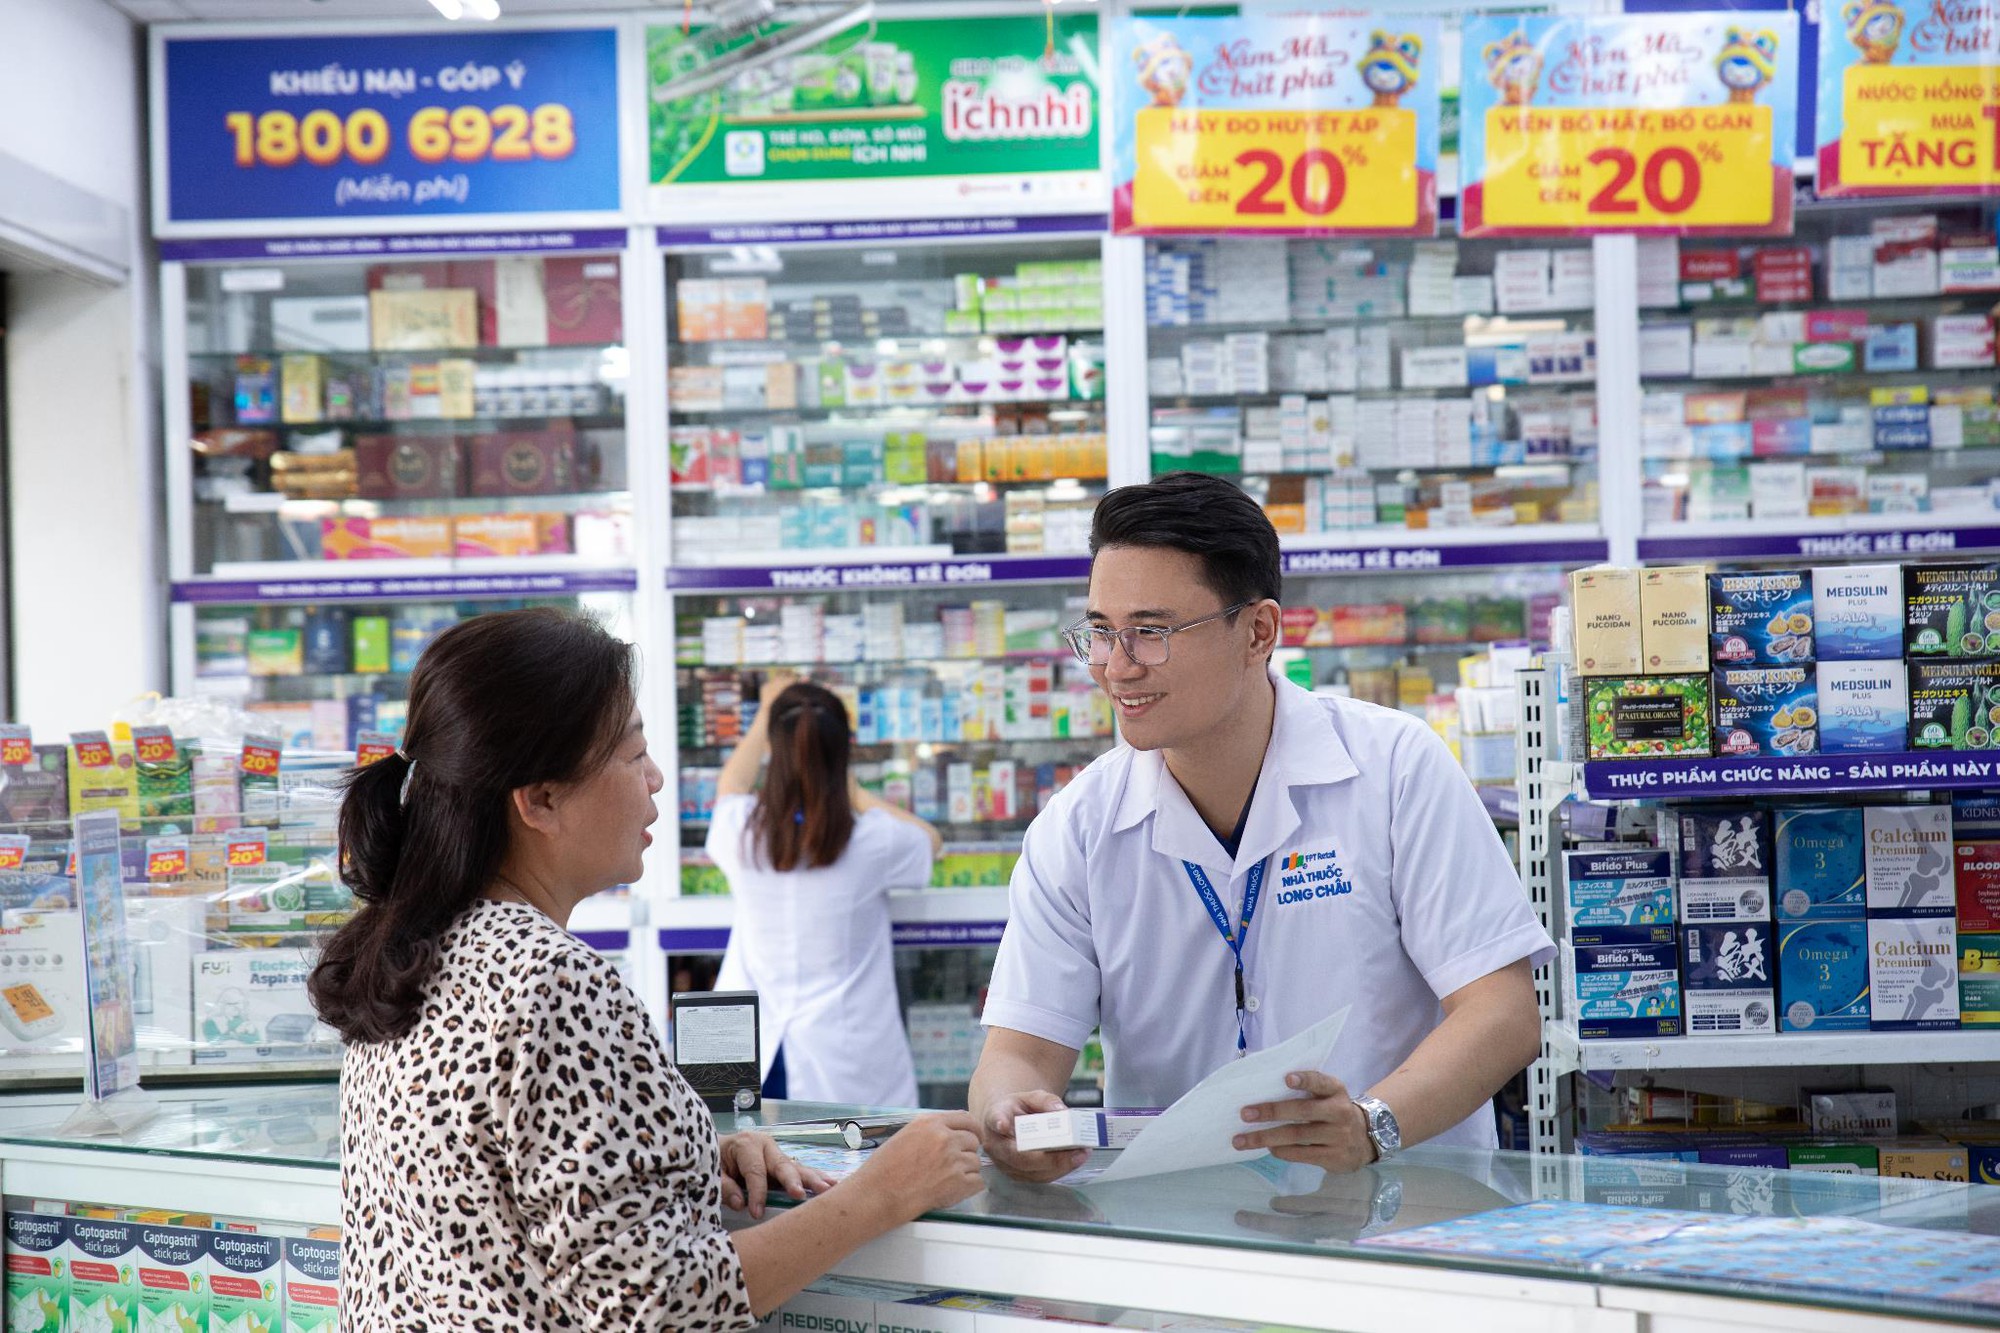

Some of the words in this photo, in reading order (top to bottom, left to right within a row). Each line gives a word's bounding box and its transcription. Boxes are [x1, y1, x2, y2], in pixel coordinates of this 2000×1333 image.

[270, 64, 358, 95] KHIẾU
[364, 69, 416, 98] NẠI
[438, 62, 500, 92] GÓP
[1226, 116, 1260, 134] ĐO
[1268, 112, 1341, 134] HUYẾT
[1348, 111, 1379, 133] ÁP
[1703, 114, 1752, 130] GAN
[1932, 114, 1975, 129] MUA
[226, 107, 390, 166] 1800
[408, 103, 575, 163] 6928
[1860, 132, 1976, 177] TẶNG
[1798, 531, 1872, 556] THUỐC
[1875, 531, 1903, 551] KÊ
[1906, 531, 1956, 550] ĐƠN
[1288, 549, 1361, 569] KHÔNG
[1394, 548, 1441, 567] ĐƠN
[770, 562, 838, 587] THUỐC
[842, 562, 912, 585] KHÔNG
[945, 561, 991, 582] ĐƠN
[1917, 570, 1968, 583] MEDSULIN
[1970, 570, 1998, 583] GOLD
[1731, 589, 1792, 602] ベストキング
[1826, 586, 1888, 597] MEDSULIN
[1909, 595, 1964, 604] ニガウリエキス
[1715, 605, 1733, 613] マカ
[1596, 614, 1621, 622] NANO
[1652, 618, 1697, 627] FUCOIDAN
[1587, 621, 1631, 630] FUCOIDAN
[1921, 665, 1973, 677] MEDSULIN
[1736, 683, 1796, 695] ベストキング
[1831, 679, 1891, 691] MEDSULIN
[1852, 692, 1871, 700] PLUS
[1913, 689, 1968, 698] ニガウリエキス
[1720, 698, 1737, 706] マカ
[1625, 711, 1652, 720] NATURAL
[1652, 711, 1680, 719] ORGANIC
[1608, 770, 1658, 789] THỰC
[1663, 765, 1717, 785] PHẨM
[1721, 764, 1773, 783] CHỨC
[1778, 763, 1831, 782] NĂNG
[1849, 761, 1887, 779] SẢN
[1891, 759, 1948, 778] PHẨM
[1952, 759, 1992, 777] NÀY
[1870, 828, 1947, 843] Calcium
[1794, 837, 1844, 851] Omega
[1872, 844, 1928, 855] Premium
[1305, 853, 1316, 862] FPT
[1815, 852, 1826, 869] 3
[1591, 862, 1622, 871] Bifido
[1625, 861, 1648, 870] Plus
[1192, 869, 1207, 890] LONG
[1282, 871, 1305, 887] NHÀ
[1306, 863, 1342, 882] THUỐC
[1277, 888, 1314, 905] LONG
[1315, 878, 1352, 898] CHÂU
[1799, 948, 1849, 963] Omega
[1874, 941, 1951, 956] Calcium
[1597, 954, 1628, 964] Bifido
[1632, 953, 1655, 962] Plus
[1876, 957, 1932, 968] Premium
[1820, 964, 1830, 981] 3
[1818, 1115, 1893, 1132] Calcium
[74, 1223, 127, 1242] Captogastril
[143, 1230, 198, 1249] Captogastril
[18, 1235, 34, 1245] stick
[36, 1236, 53, 1248] pack
[84, 1241, 102, 1252] stick
[103, 1243, 120, 1254] pack
[213, 1237, 271, 1255] Captogastril
[153, 1248, 171, 1259] stick
[172, 1250, 191, 1262] pack
[292, 1243, 340, 1262] Captogast
[225, 1255, 242, 1267] stick
[244, 1257, 263, 1269] pack
[303, 1262, 322, 1274] stick
[783, 1312, 868, 1333] REDISOLV
